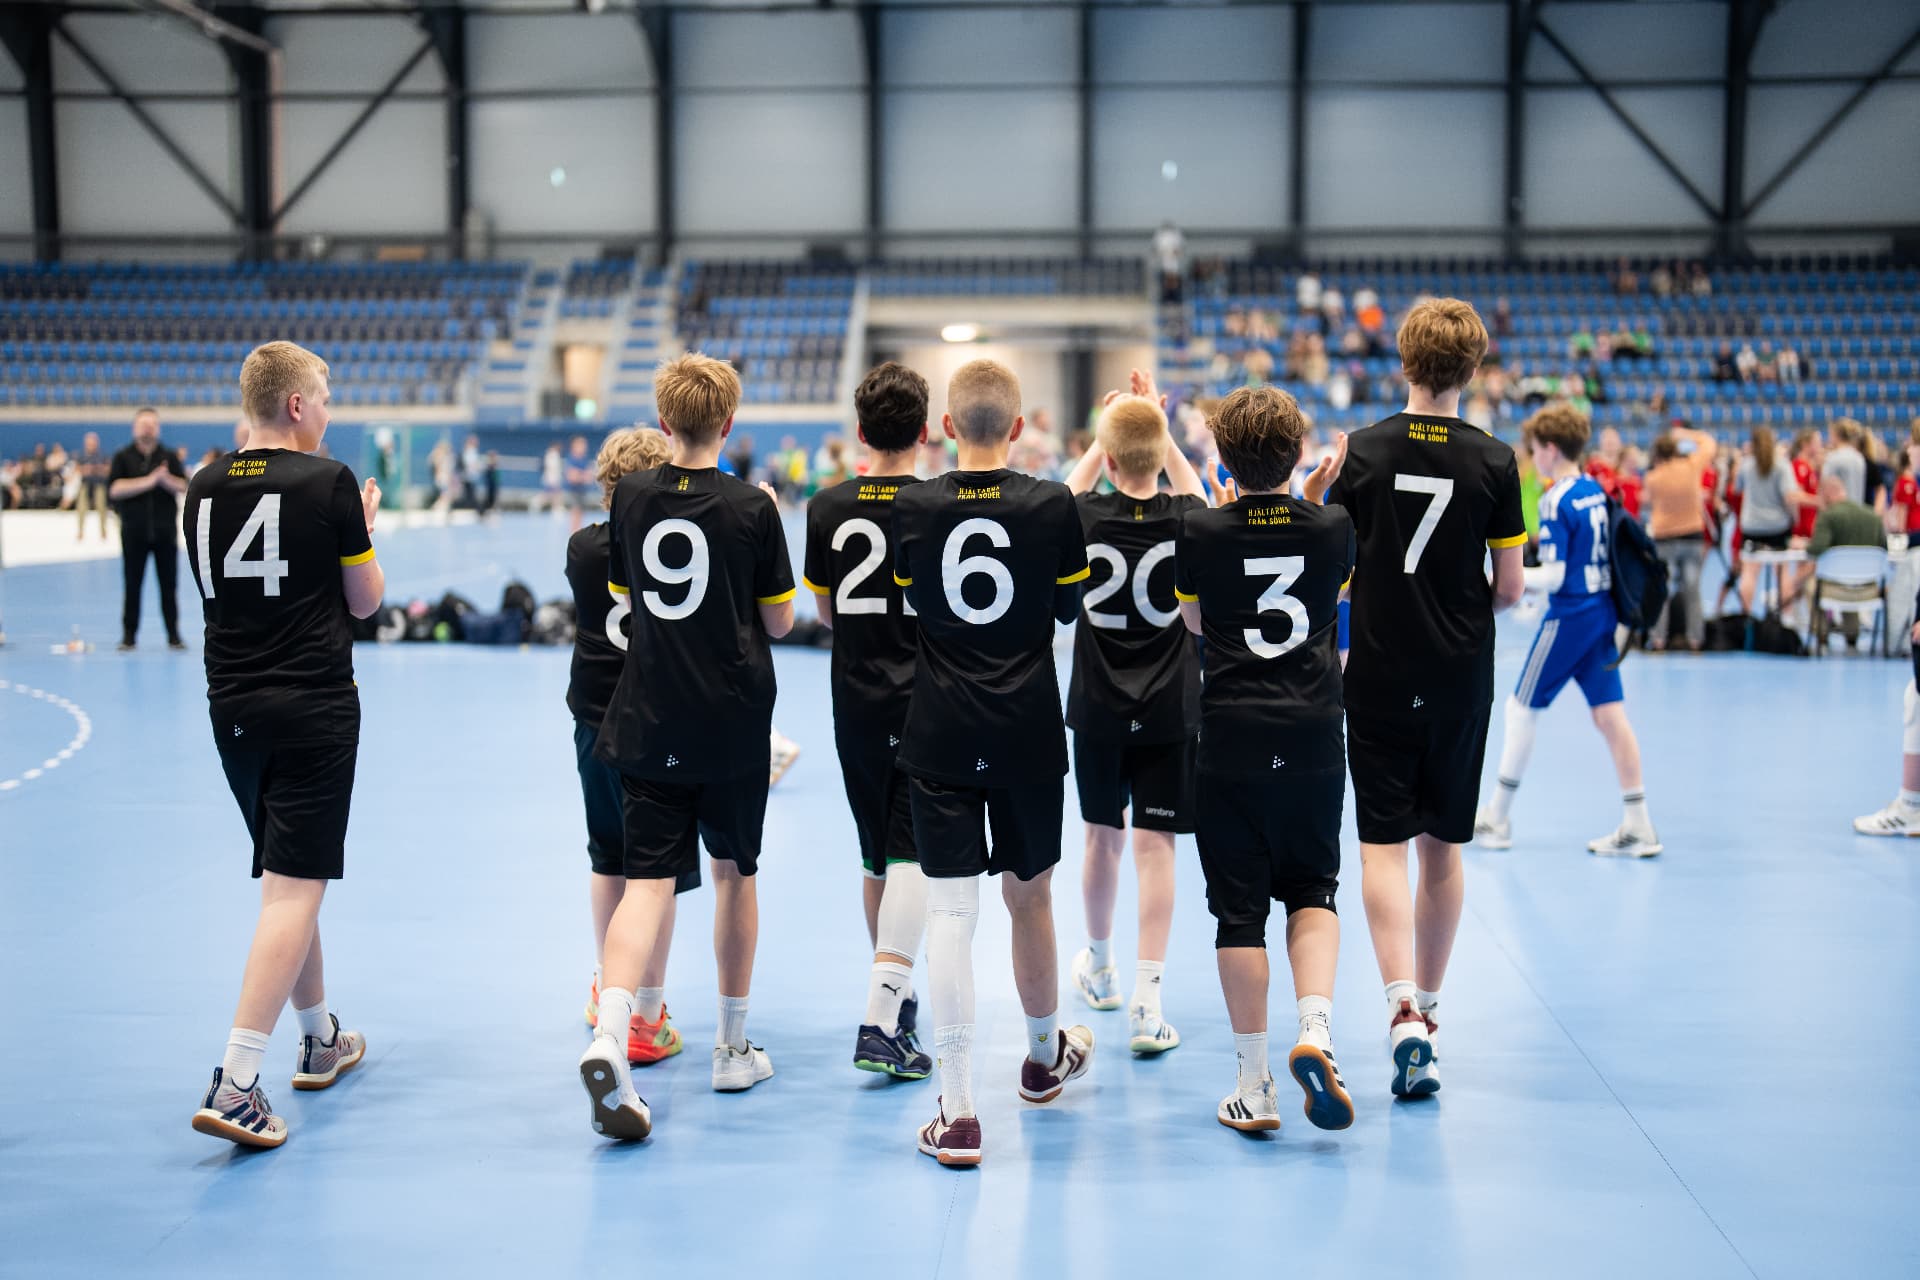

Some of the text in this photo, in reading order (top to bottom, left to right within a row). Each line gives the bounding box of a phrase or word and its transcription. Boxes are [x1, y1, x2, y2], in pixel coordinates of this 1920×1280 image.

[1408, 431, 1448, 443] FRÅN SÖDER
[1409, 422, 1448, 434] HJÄLTARNA
[196, 493, 289, 599] 14
[1248, 506, 1290, 517] HJÄLTARNA
[1248, 516, 1292, 525] FRÅN SÖDER
[1394, 473, 1454, 574] 7
[642, 518, 710, 620] 9
[831, 518, 918, 616] 2
[941, 518, 1014, 625] 6
[1243, 555, 1310, 659] 3
[1145, 806, 1175, 817] umbro
